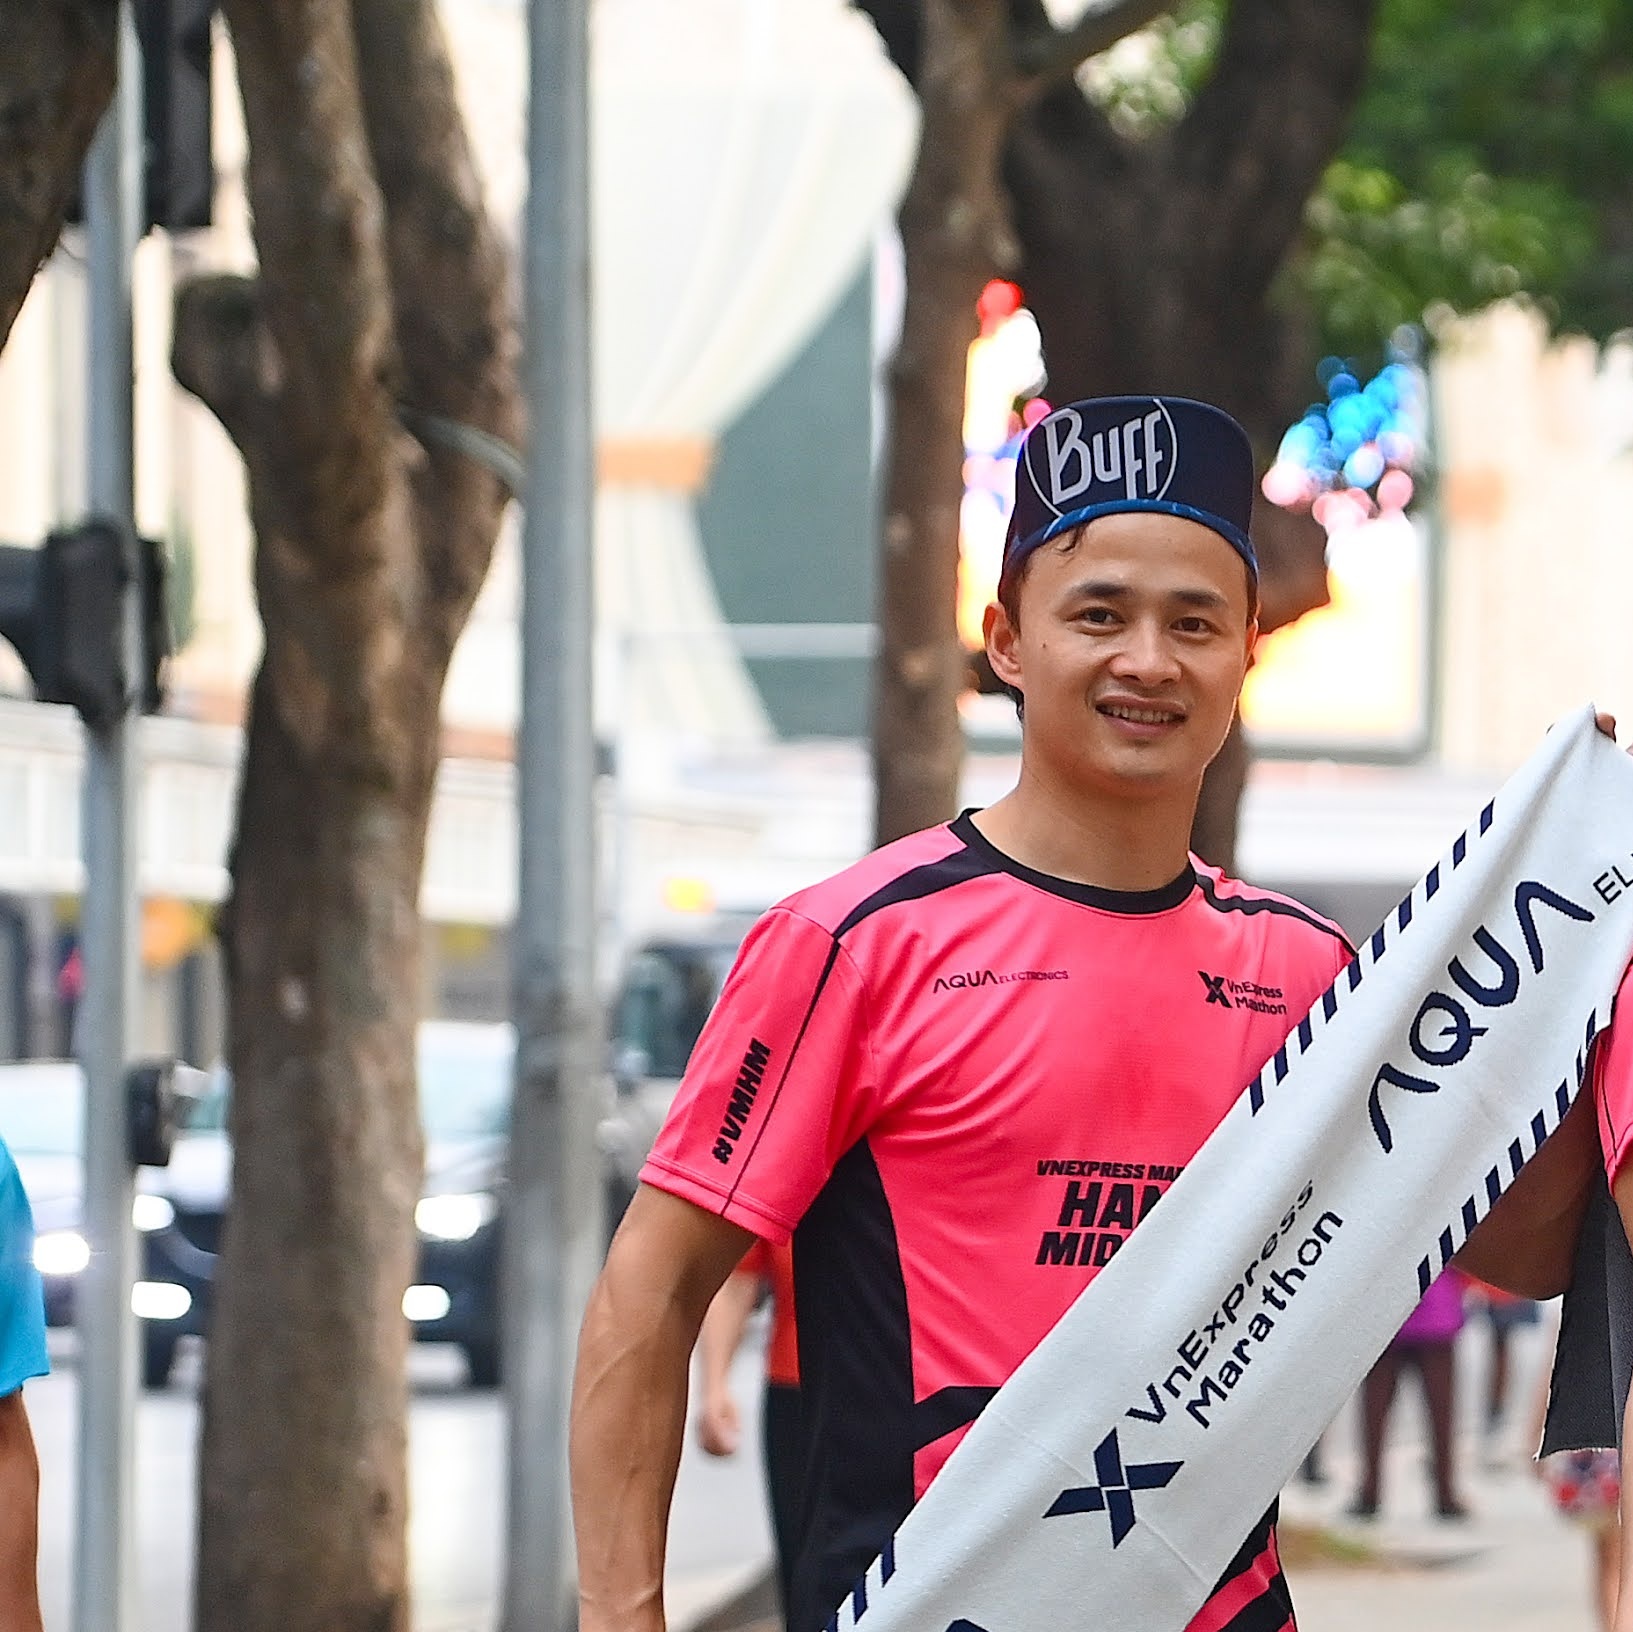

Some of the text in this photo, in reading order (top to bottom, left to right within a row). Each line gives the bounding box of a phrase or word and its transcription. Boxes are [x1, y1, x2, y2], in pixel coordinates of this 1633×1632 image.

[932, 970, 999, 994] AQUA
[1369, 881, 1596, 1154] AQUA
[712, 1037, 772, 1165] #VMHM
[1036, 1160, 1146, 1179] VNEXPRESS
[1127, 1178, 1315, 1426] VnExpress
[1185, 1211, 1344, 1429] Marathon
